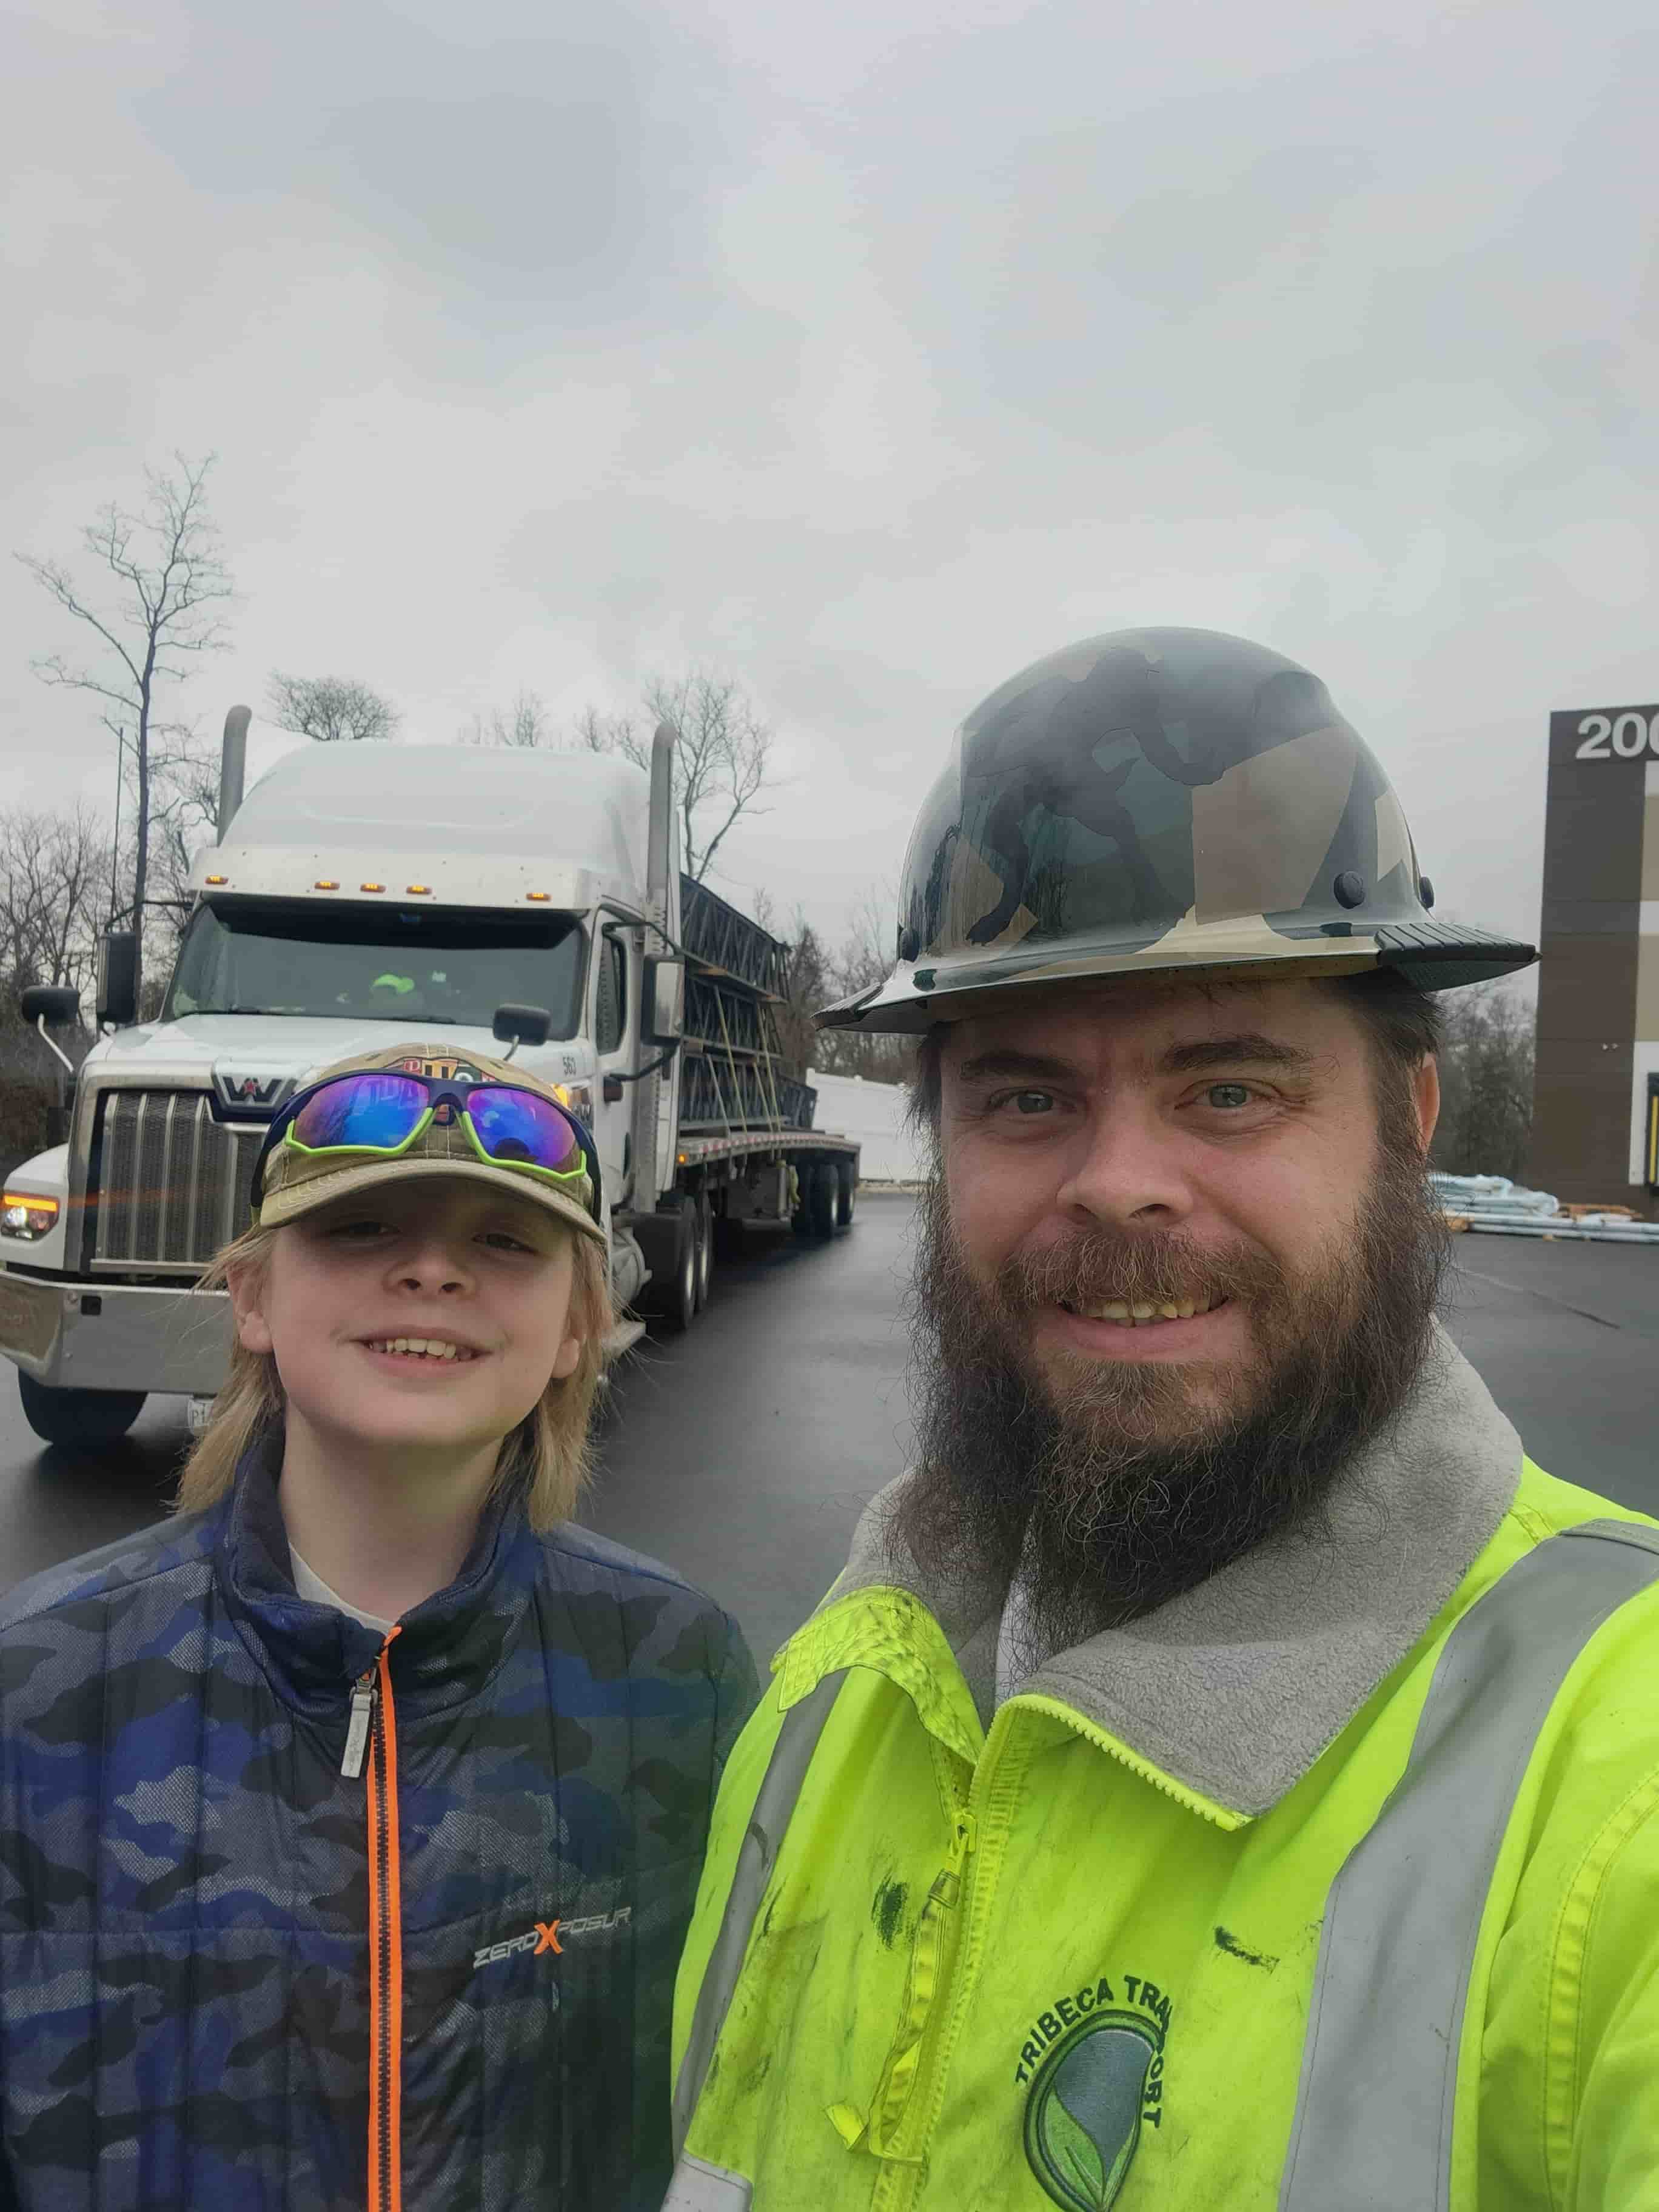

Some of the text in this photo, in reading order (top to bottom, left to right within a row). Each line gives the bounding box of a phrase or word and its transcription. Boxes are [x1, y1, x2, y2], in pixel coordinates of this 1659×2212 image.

[1575, 712, 1659, 759] 20
[1016, 1975, 1173, 2128] TRIBECA TRAORT
